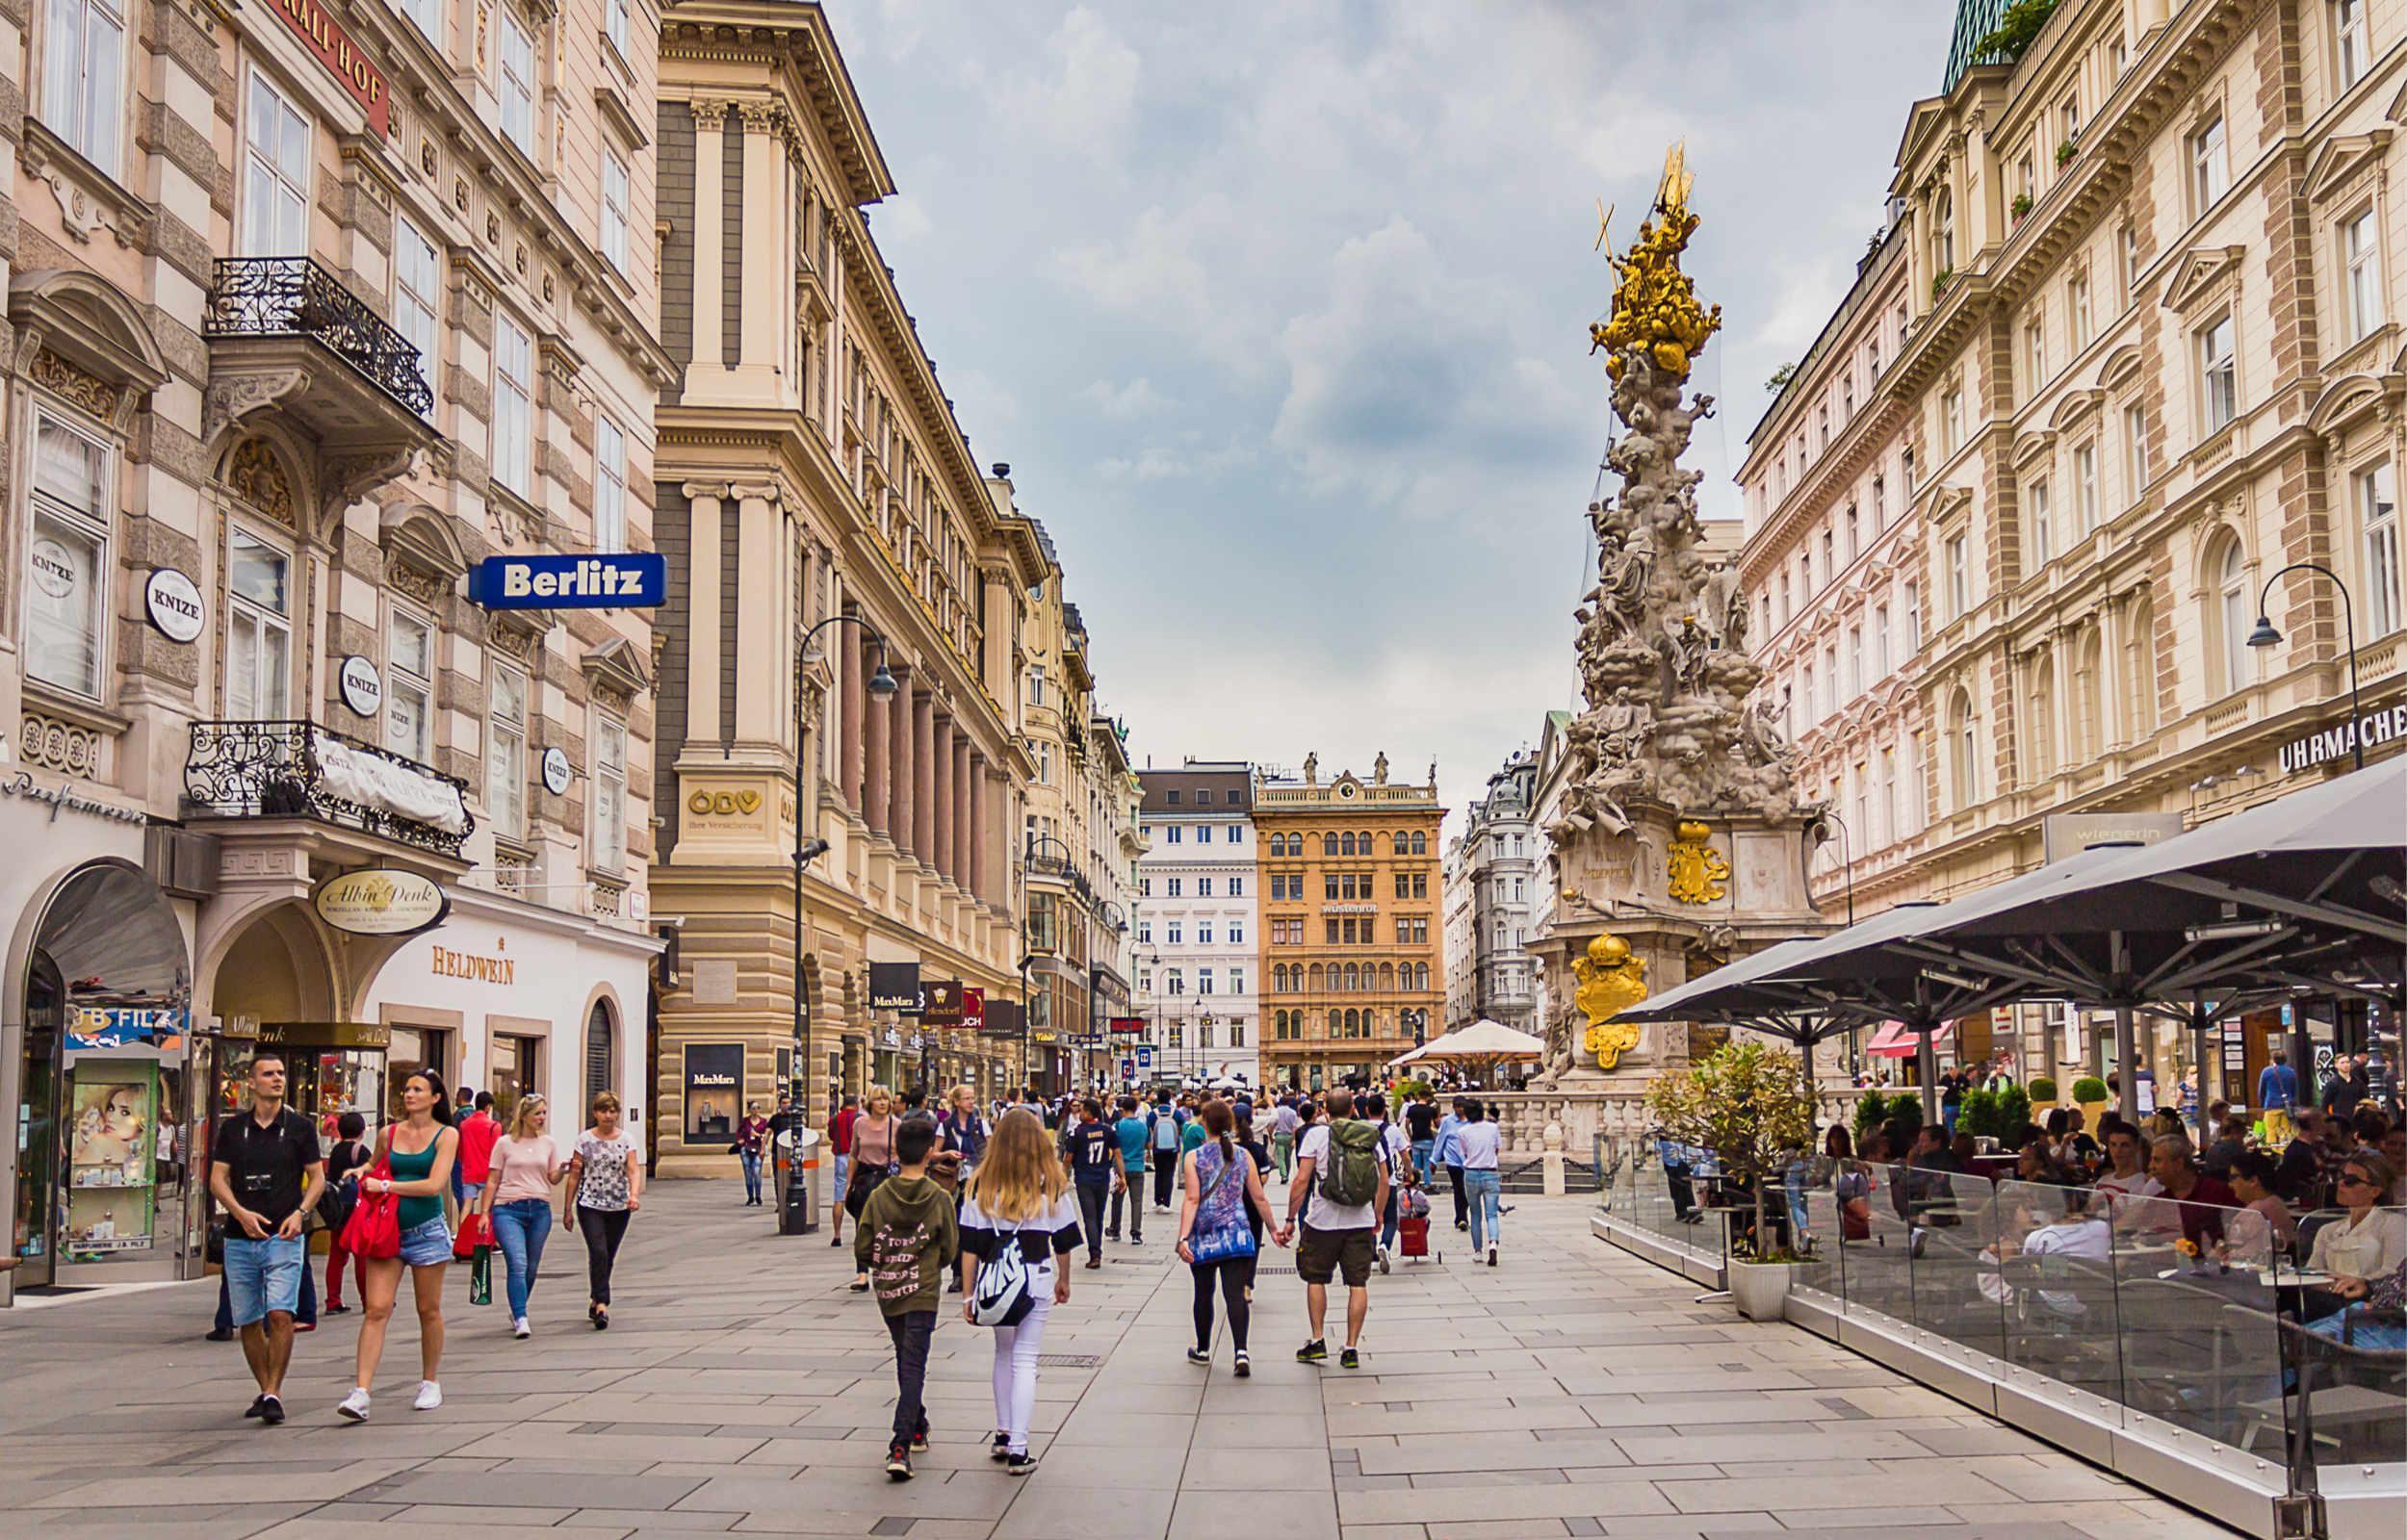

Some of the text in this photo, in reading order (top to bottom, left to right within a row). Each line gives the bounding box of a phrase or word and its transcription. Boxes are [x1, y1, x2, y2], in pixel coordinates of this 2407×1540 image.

[504, 560, 643, 597] Berlitz
[154, 588, 199, 620] KNIZE
[348, 674, 378, 696] KNIZE
[2076, 827, 2161, 840] wienerin
[326, 885, 432, 904] Albin Denk
[1322, 904, 1379, 913] wüstenrot
[431, 945, 514, 985] HELDWEIN
[874, 995, 914, 1007] MaxMara
[117, 1008, 171, 1028] FILZ
[693, 1073, 736, 1085] MaxMara
[1088, 1141, 1104, 1164] 17
[978, 1238, 1022, 1300] NIKE
